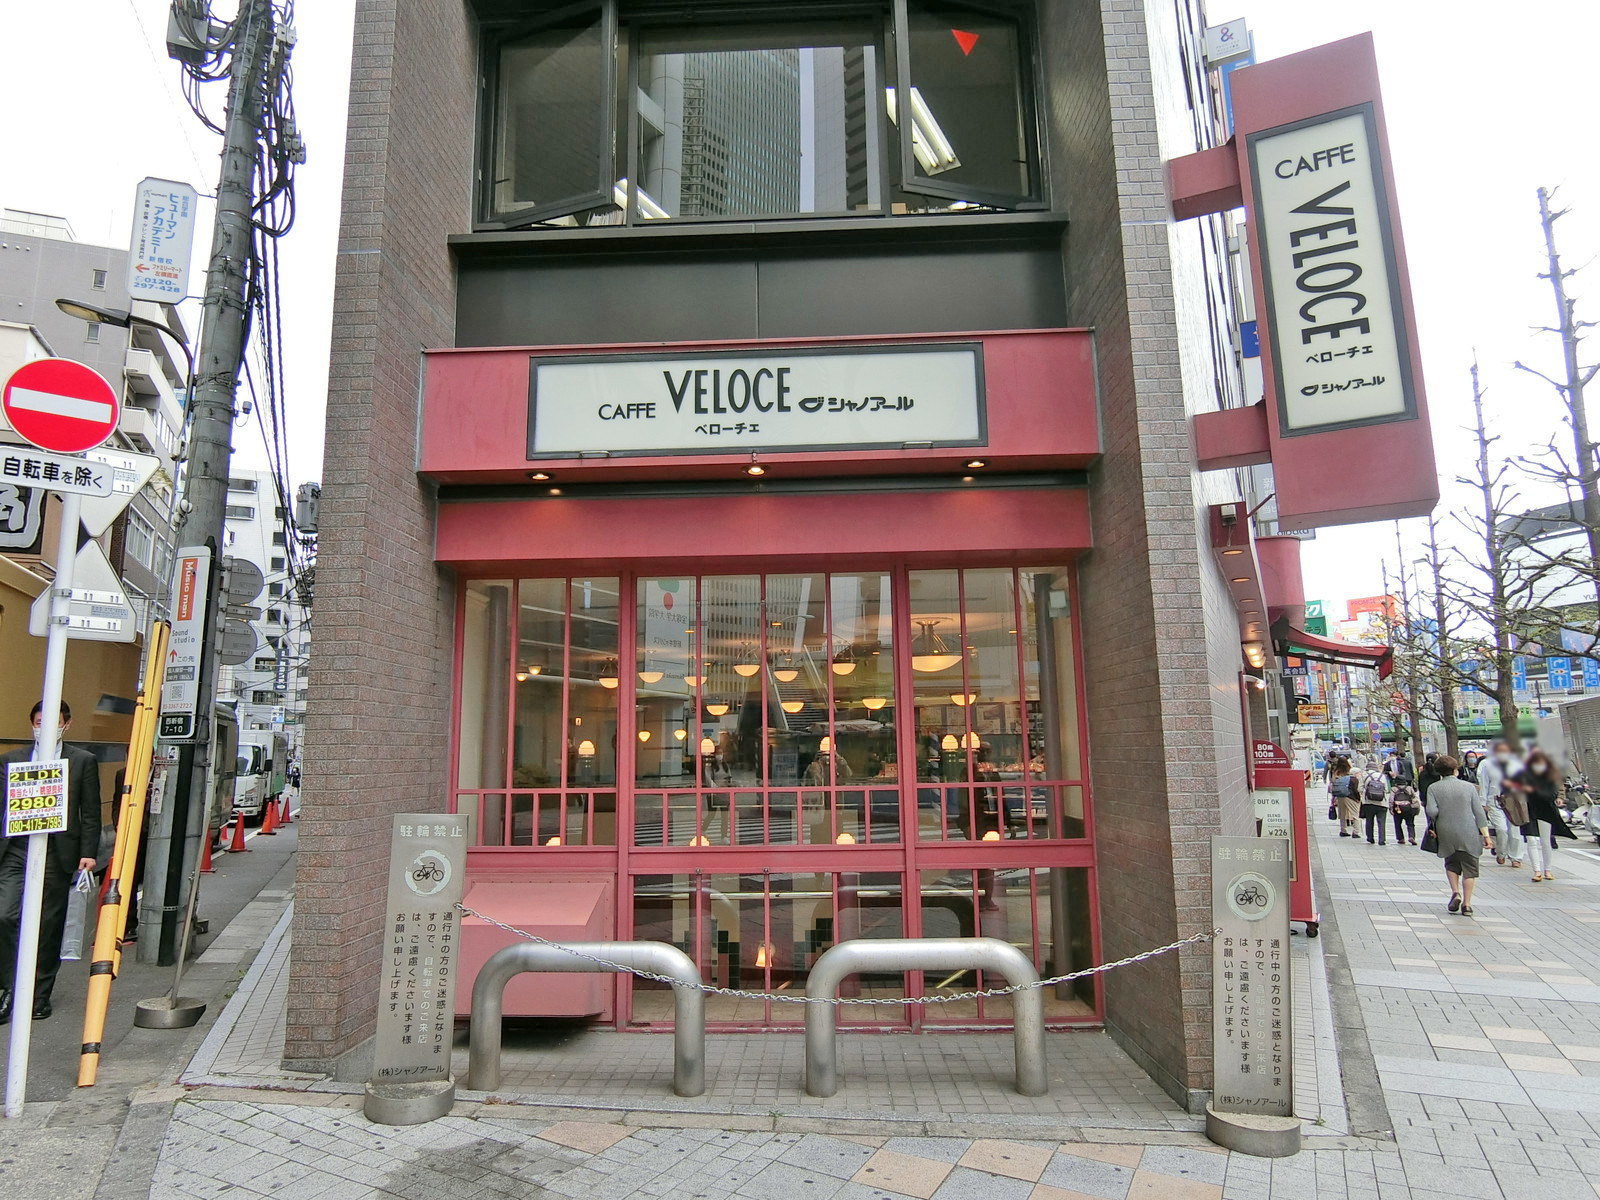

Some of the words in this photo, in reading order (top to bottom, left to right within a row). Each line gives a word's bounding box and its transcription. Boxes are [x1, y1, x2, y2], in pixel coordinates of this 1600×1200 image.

[1275, 143, 1355, 179] CAFFE
[165, 193, 179, 240] ヒューマン
[151, 206, 165, 254] アカデミー
[1288, 180, 1370, 345] VELOCE
[1306, 345, 1373, 363] ベローチェ
[598, 402, 656, 420] CAFFE
[663, 367, 791, 414] VELOCE
[1321, 376, 1385, 394] シャノアール
[827, 396, 914, 412] シャノアール
[695, 422, 760, 435] ベローチェ
[4, 456, 103, 489] 自転車を除く
[174, 636, 195, 644] studio
[10, 769, 62, 782] 2LDK
[400, 825, 462, 837] 駐輪禁止
[1219, 847, 1282, 861] 駐輪禁止
[389, 912, 406, 1018] お願い申し上げます。
[433, 911, 453, 1053] 通行中の方のご迷惑となりま
[1223, 938, 1235, 1044] お願い申し上げます。
[1270, 939, 1281, 1087] 通行中の方のご迷惑となりま
[378, 1065, 445, 1077] (株)シャノアール
[1220, 1096, 1287, 1107] (株)シャノアール
